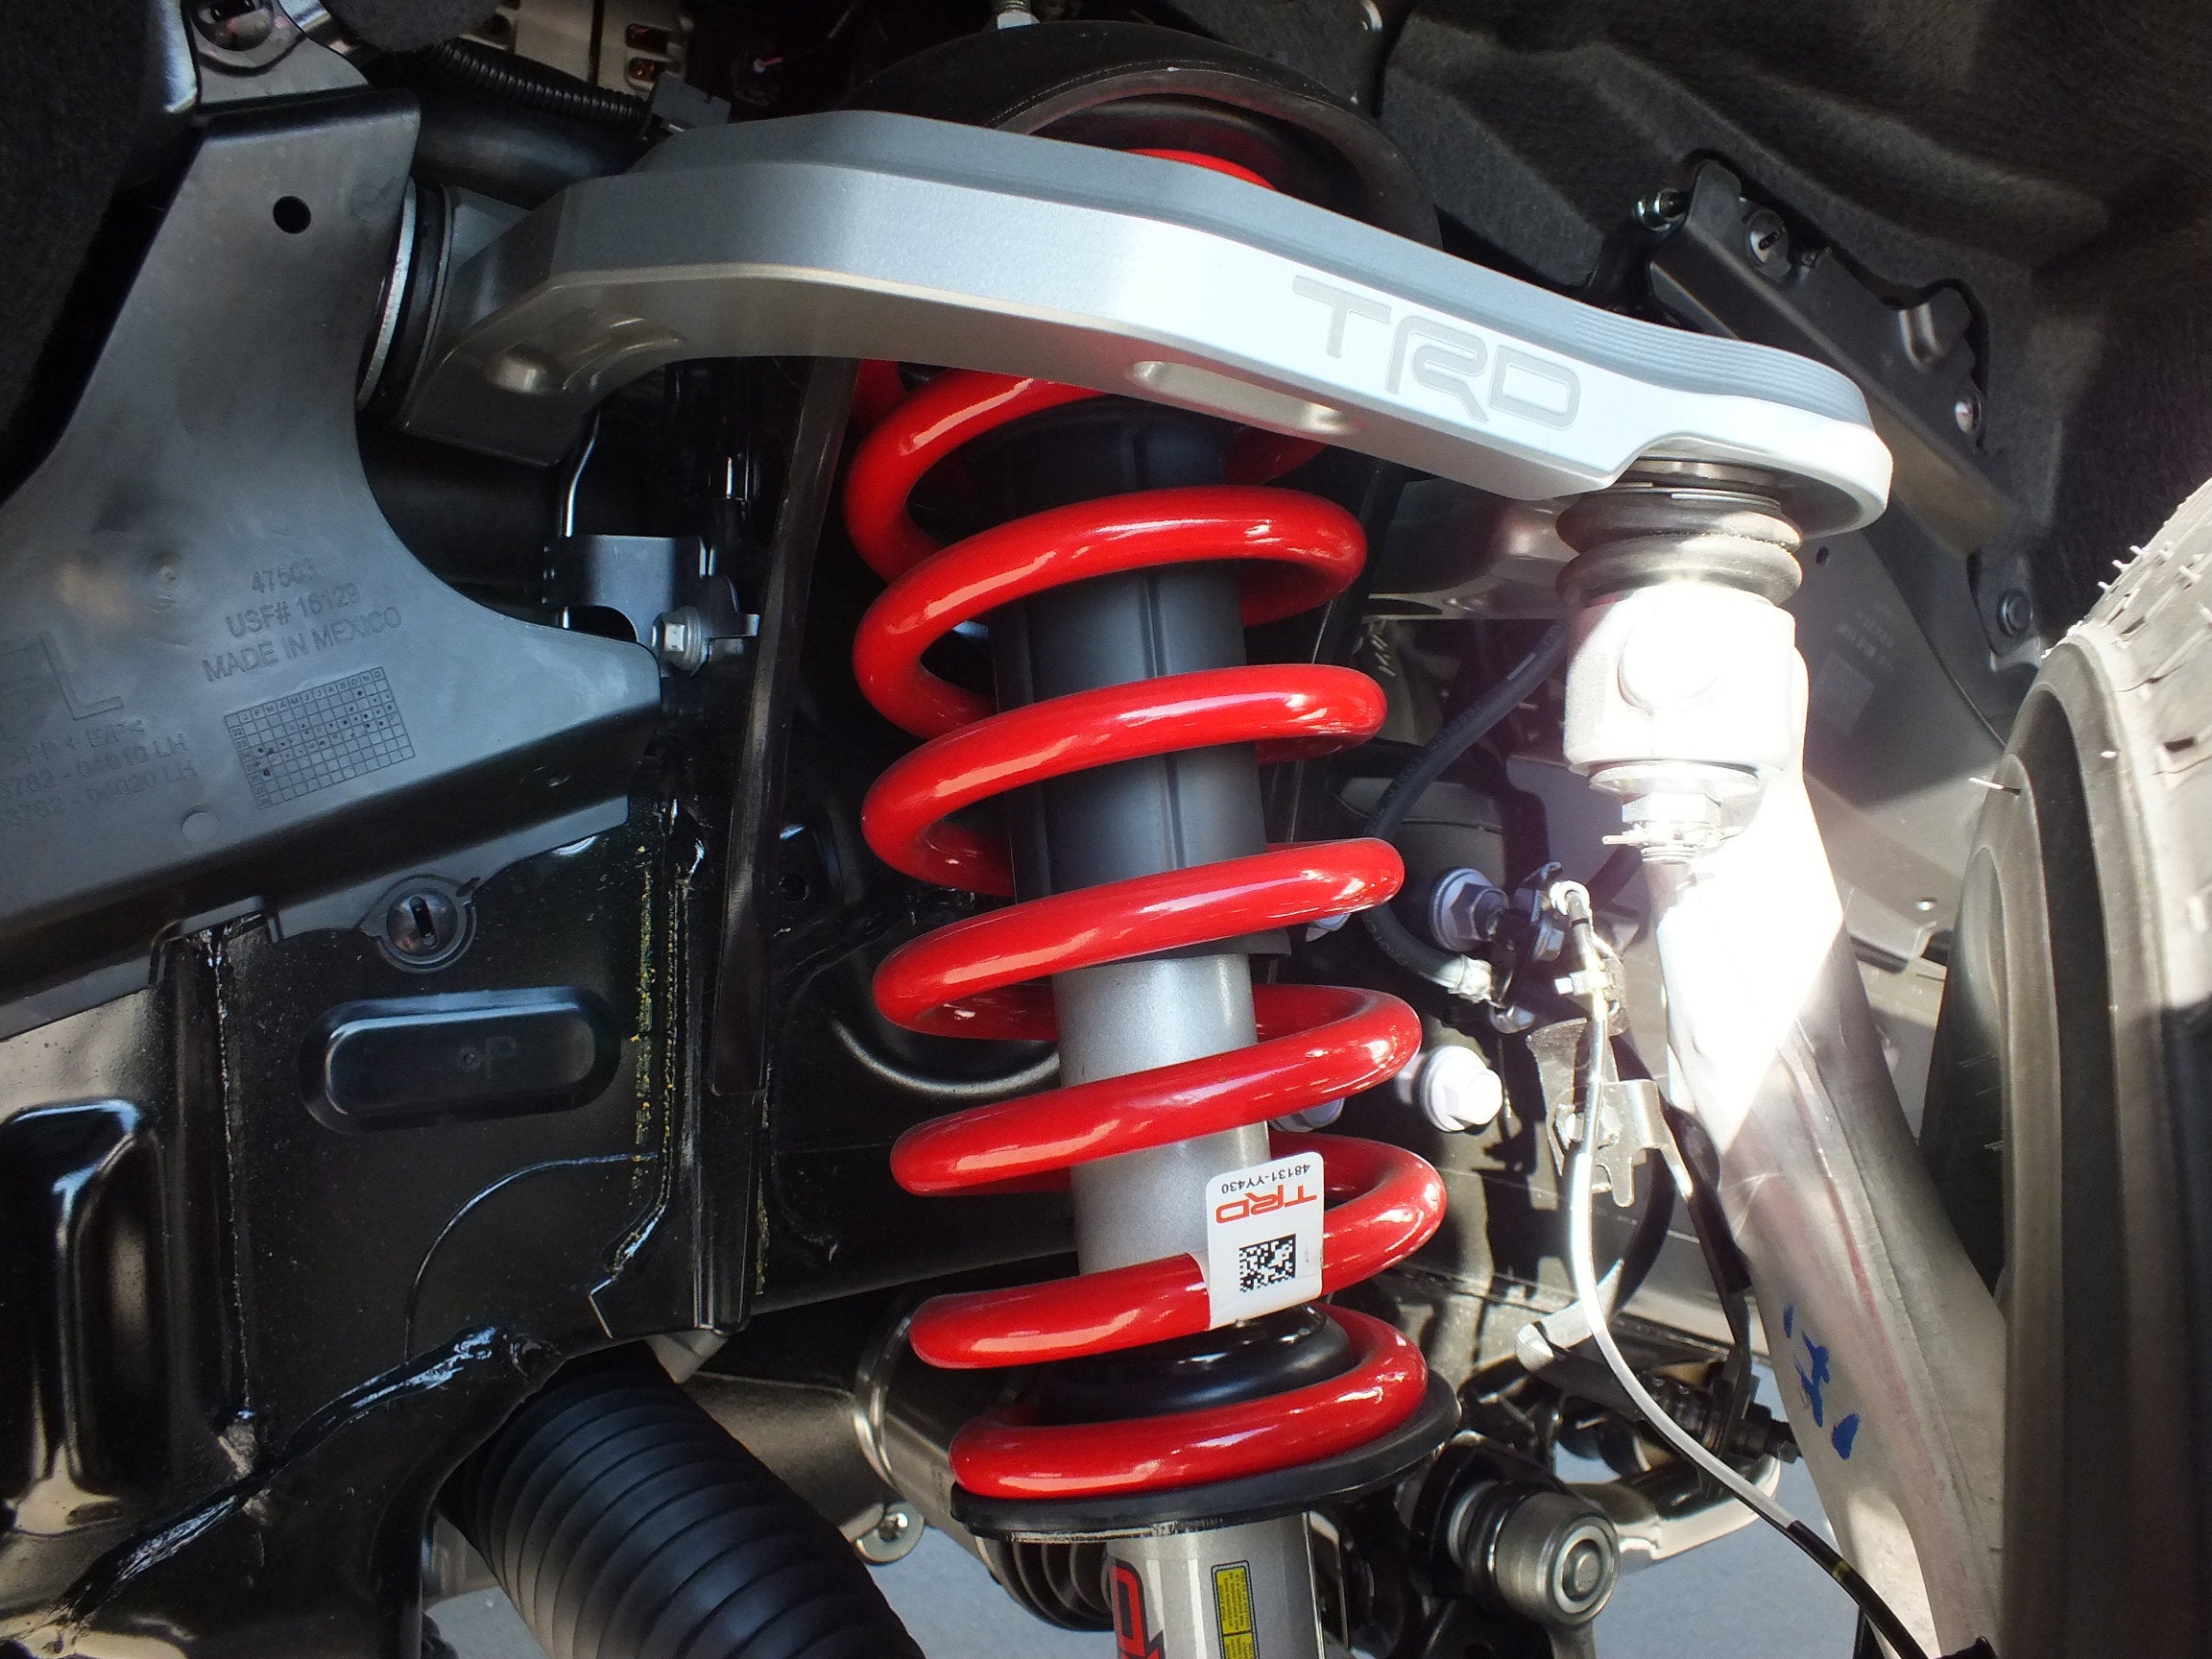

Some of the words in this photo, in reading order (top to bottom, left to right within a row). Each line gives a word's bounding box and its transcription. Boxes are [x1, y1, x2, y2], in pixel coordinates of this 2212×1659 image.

[1292, 275, 1581, 430] TRD
[202, 640, 278, 682] MADE
[281, 632, 309, 660] IN
[310, 606, 402, 652] MEXICO
[1215, 1185, 1318, 1224] TRD
[1221, 1164, 1310, 1194] 48131-YY430
